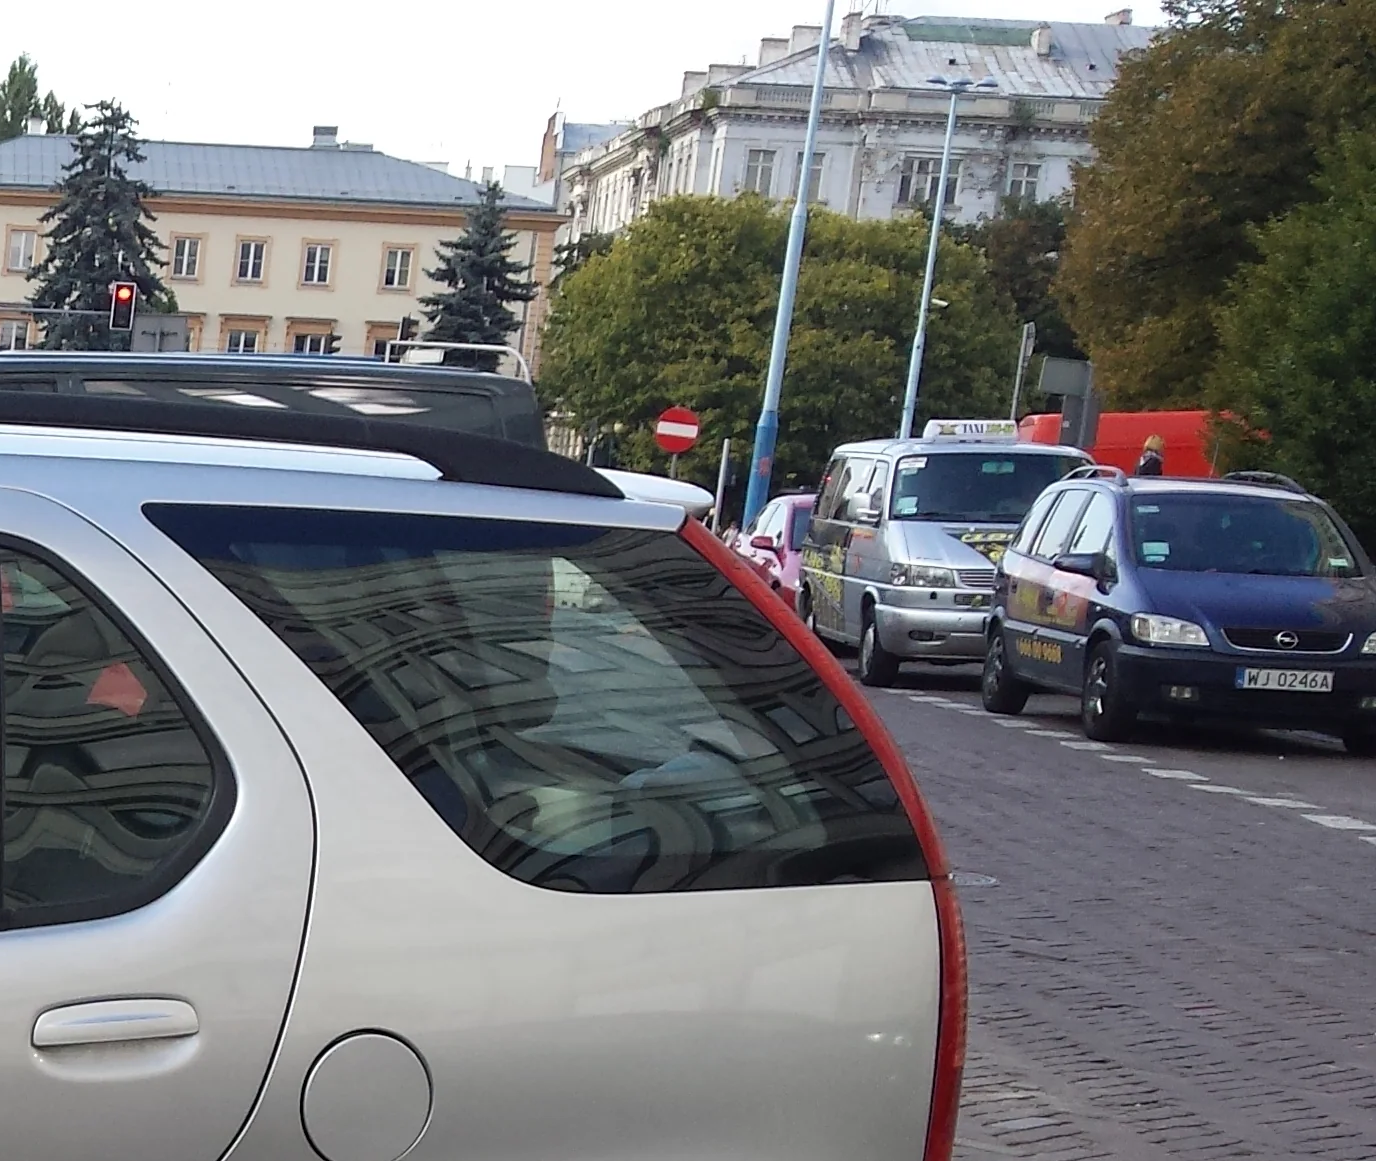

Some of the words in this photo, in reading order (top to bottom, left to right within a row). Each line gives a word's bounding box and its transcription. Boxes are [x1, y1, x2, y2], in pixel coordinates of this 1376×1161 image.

[962, 424, 984, 434] TAXI
[1247, 670, 1270, 687] WJ
[1277, 672, 1329, 690] 0246A
